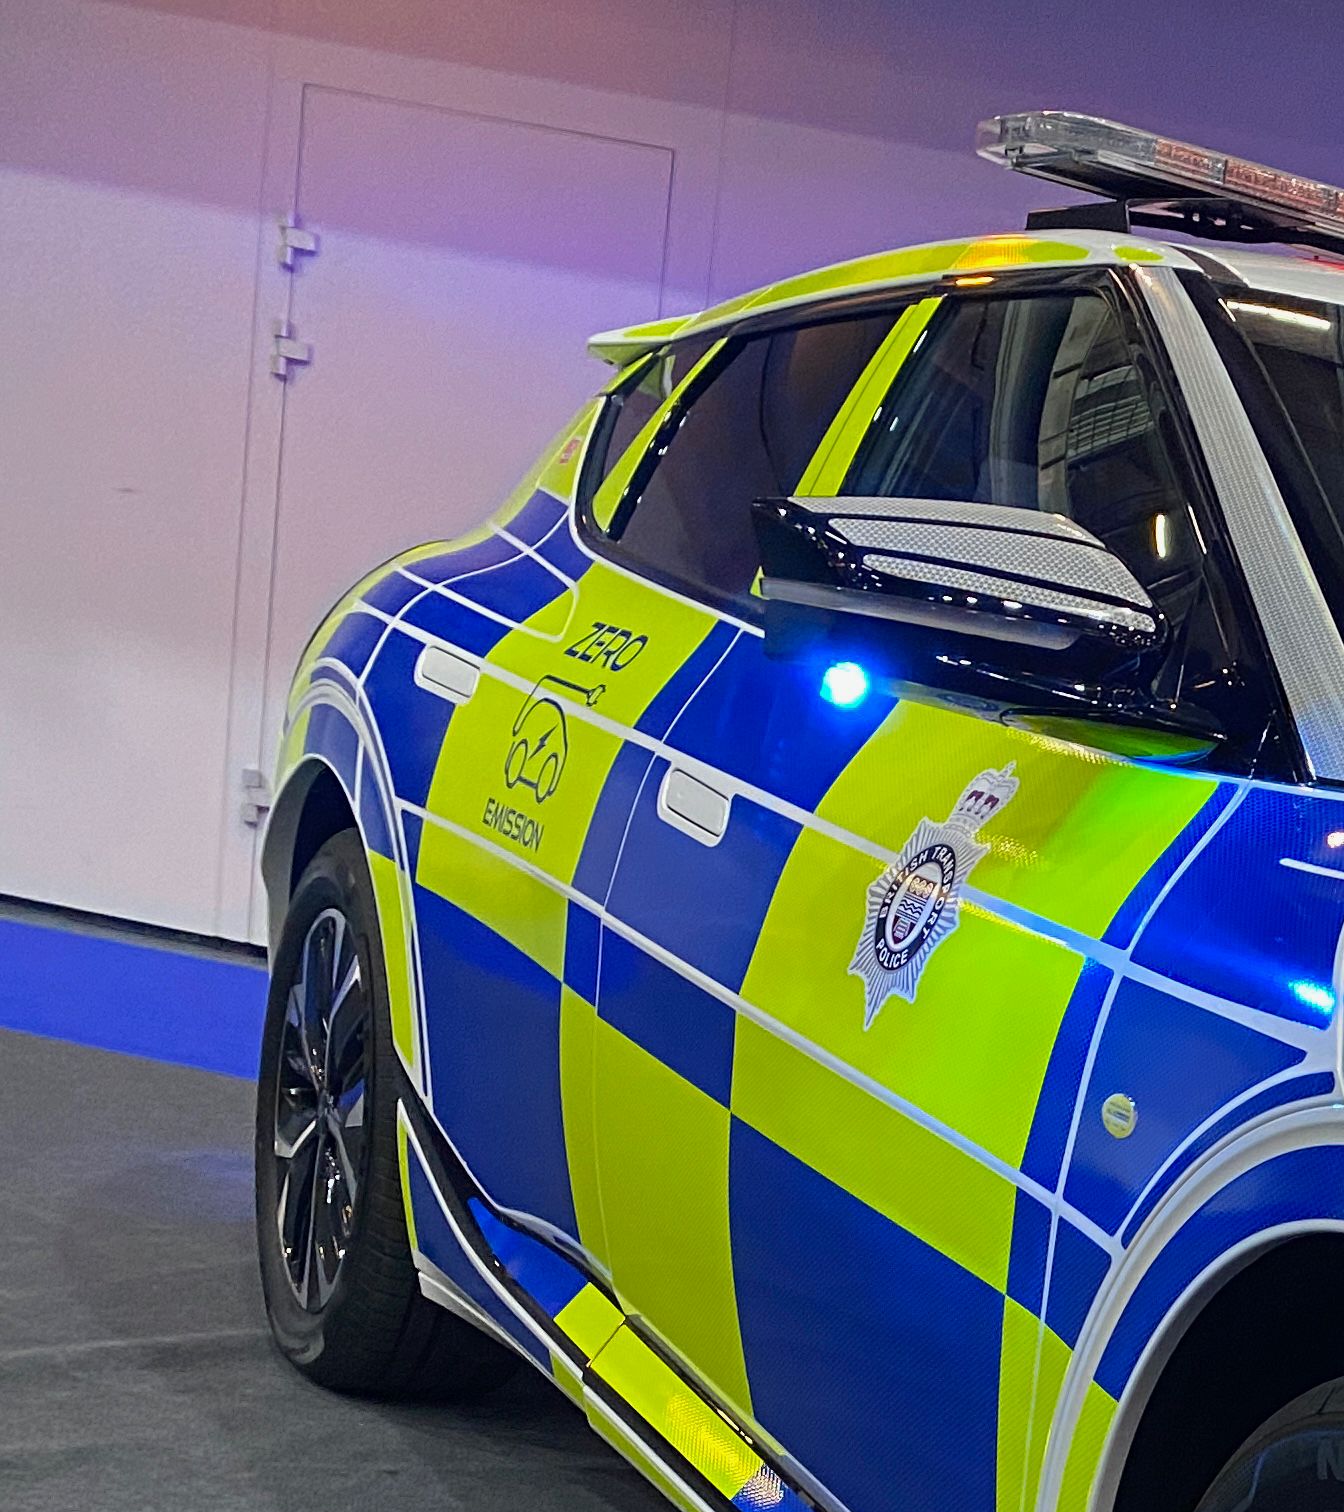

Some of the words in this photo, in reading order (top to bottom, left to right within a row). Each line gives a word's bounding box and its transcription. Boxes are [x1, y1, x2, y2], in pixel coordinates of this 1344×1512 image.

[563, 621, 649, 672] ZERO
[482, 798, 545, 853] EMISSION
[878, 849, 929, 919] BRITISH
[921, 846, 955, 940] TRANSPORT
[875, 938, 910, 969] POLICE
